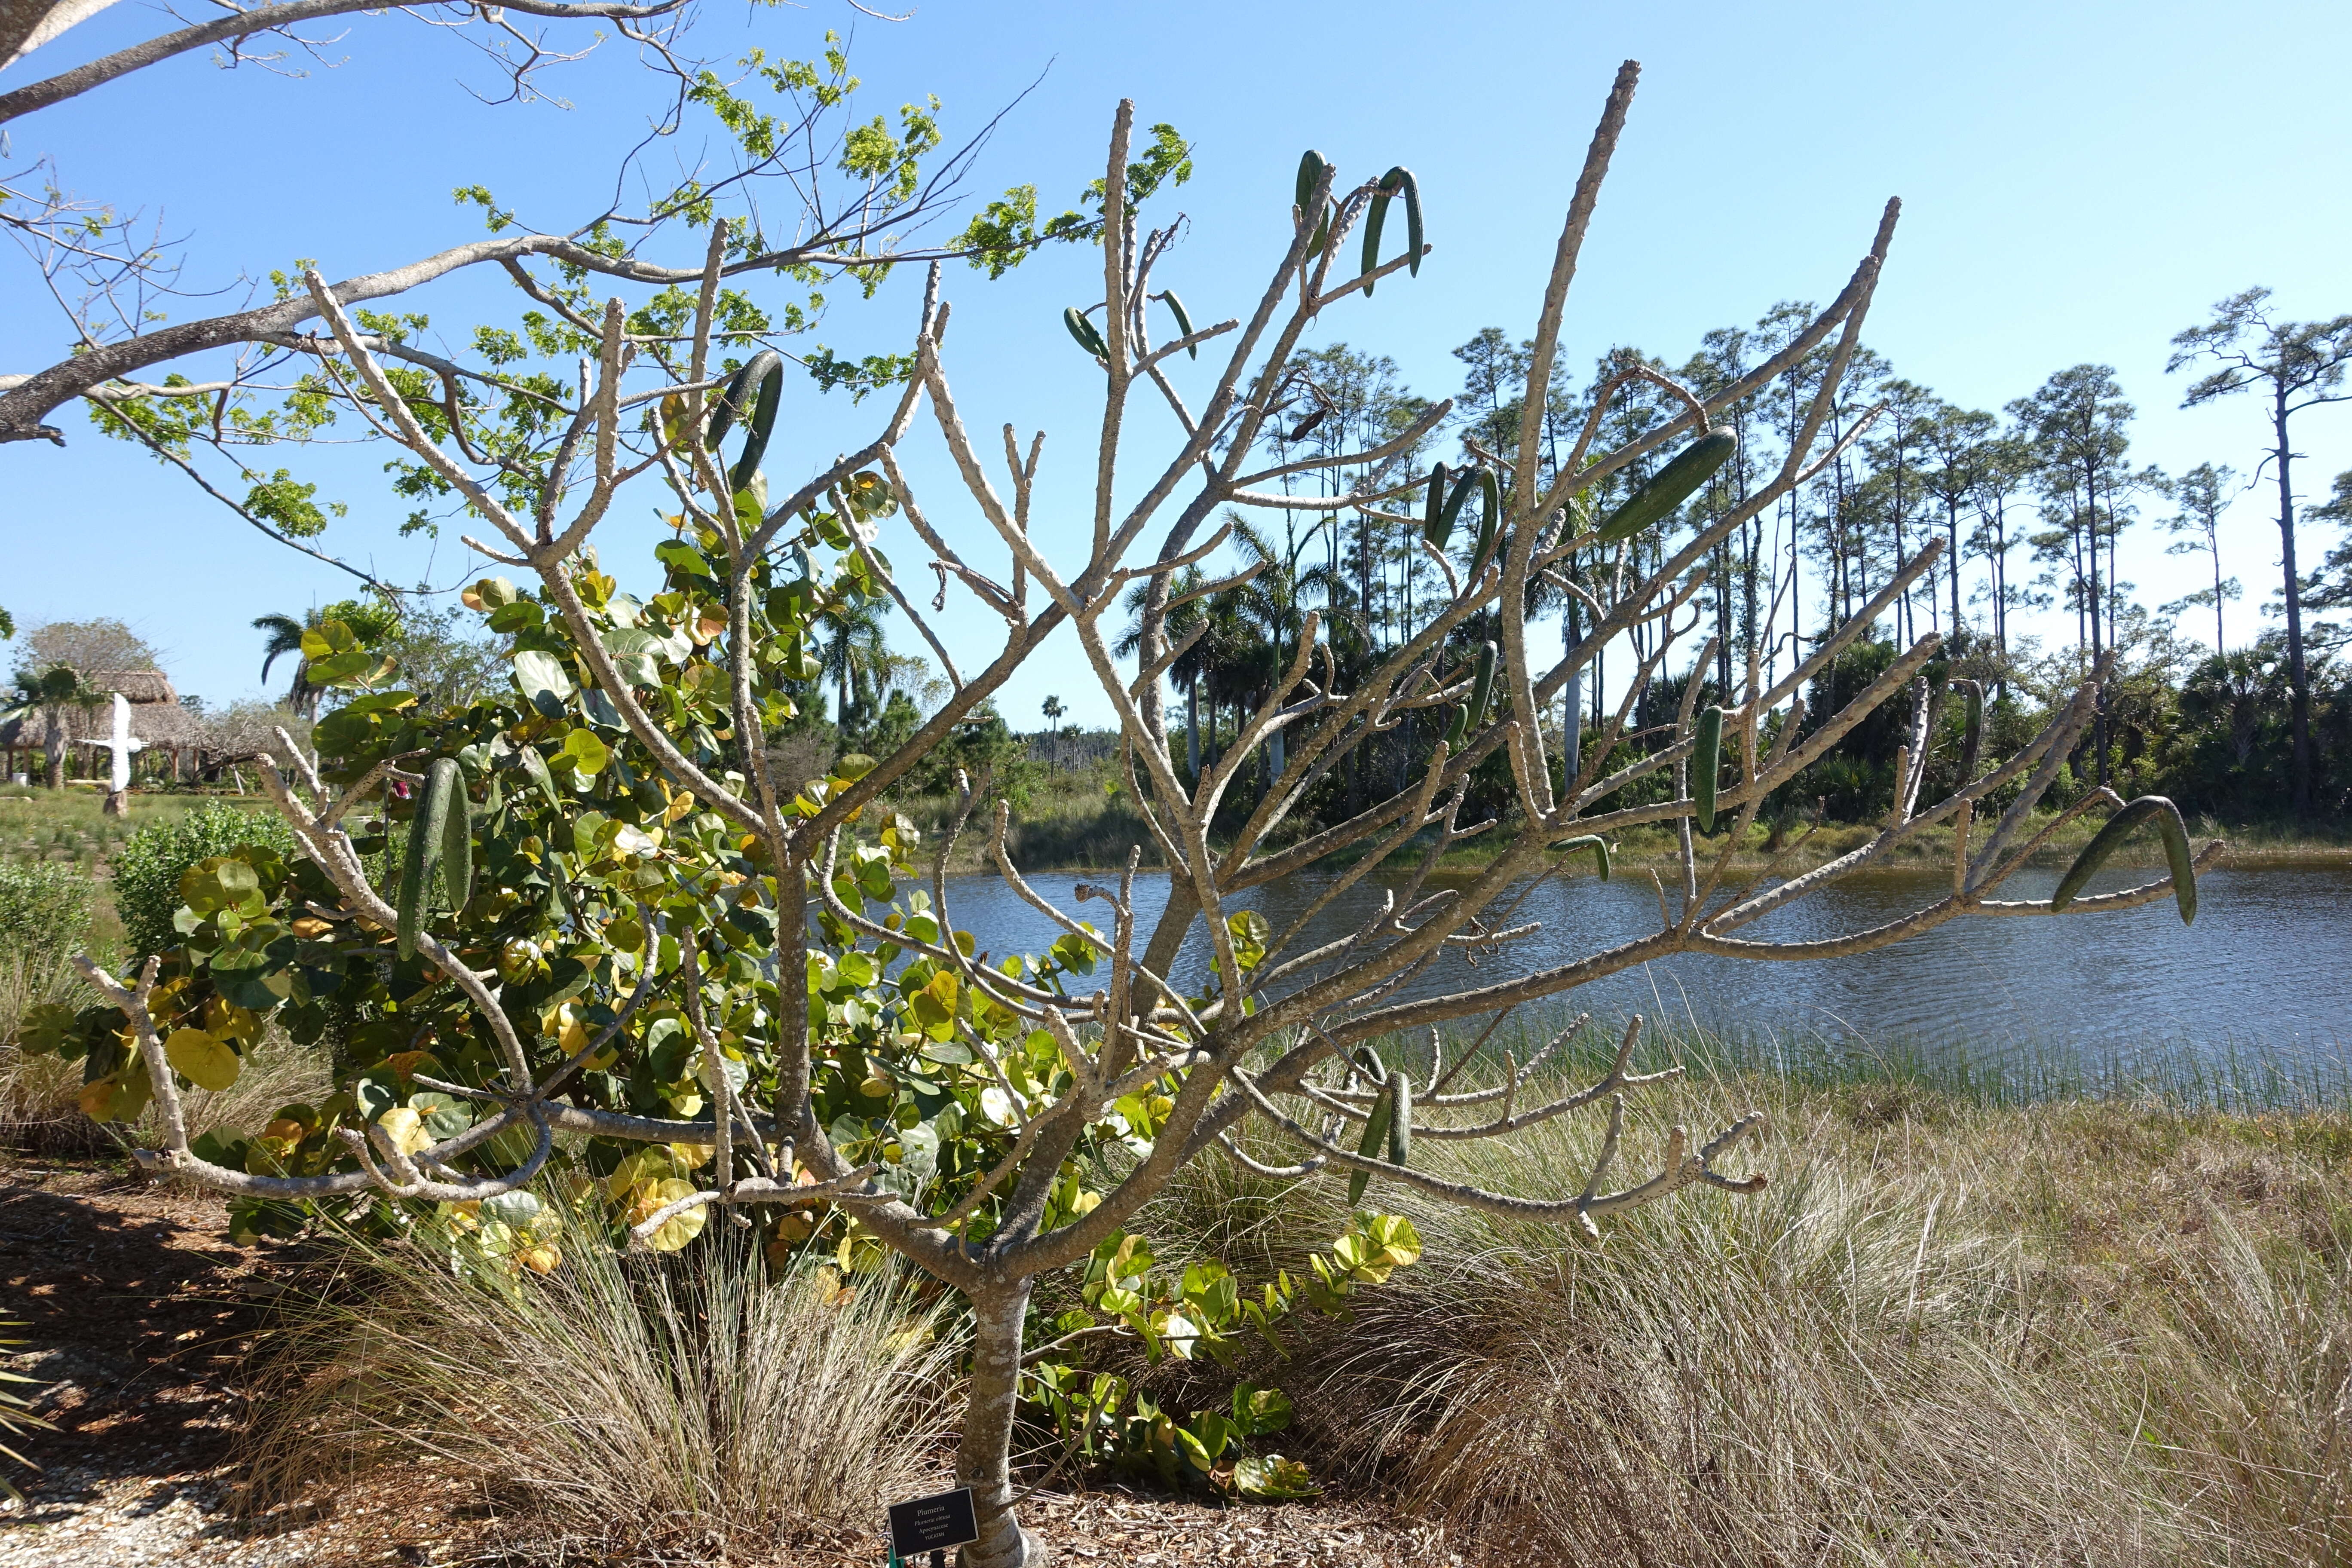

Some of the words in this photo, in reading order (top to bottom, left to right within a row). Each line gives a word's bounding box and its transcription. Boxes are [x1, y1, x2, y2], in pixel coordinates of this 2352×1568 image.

[917, 1505, 945, 1516] Plumeria
[914, 1518, 935, 1526] Plumeria
[919, 1523, 948, 1534] Apocynaceae
[925, 1531, 945, 1540] YUCATAN
